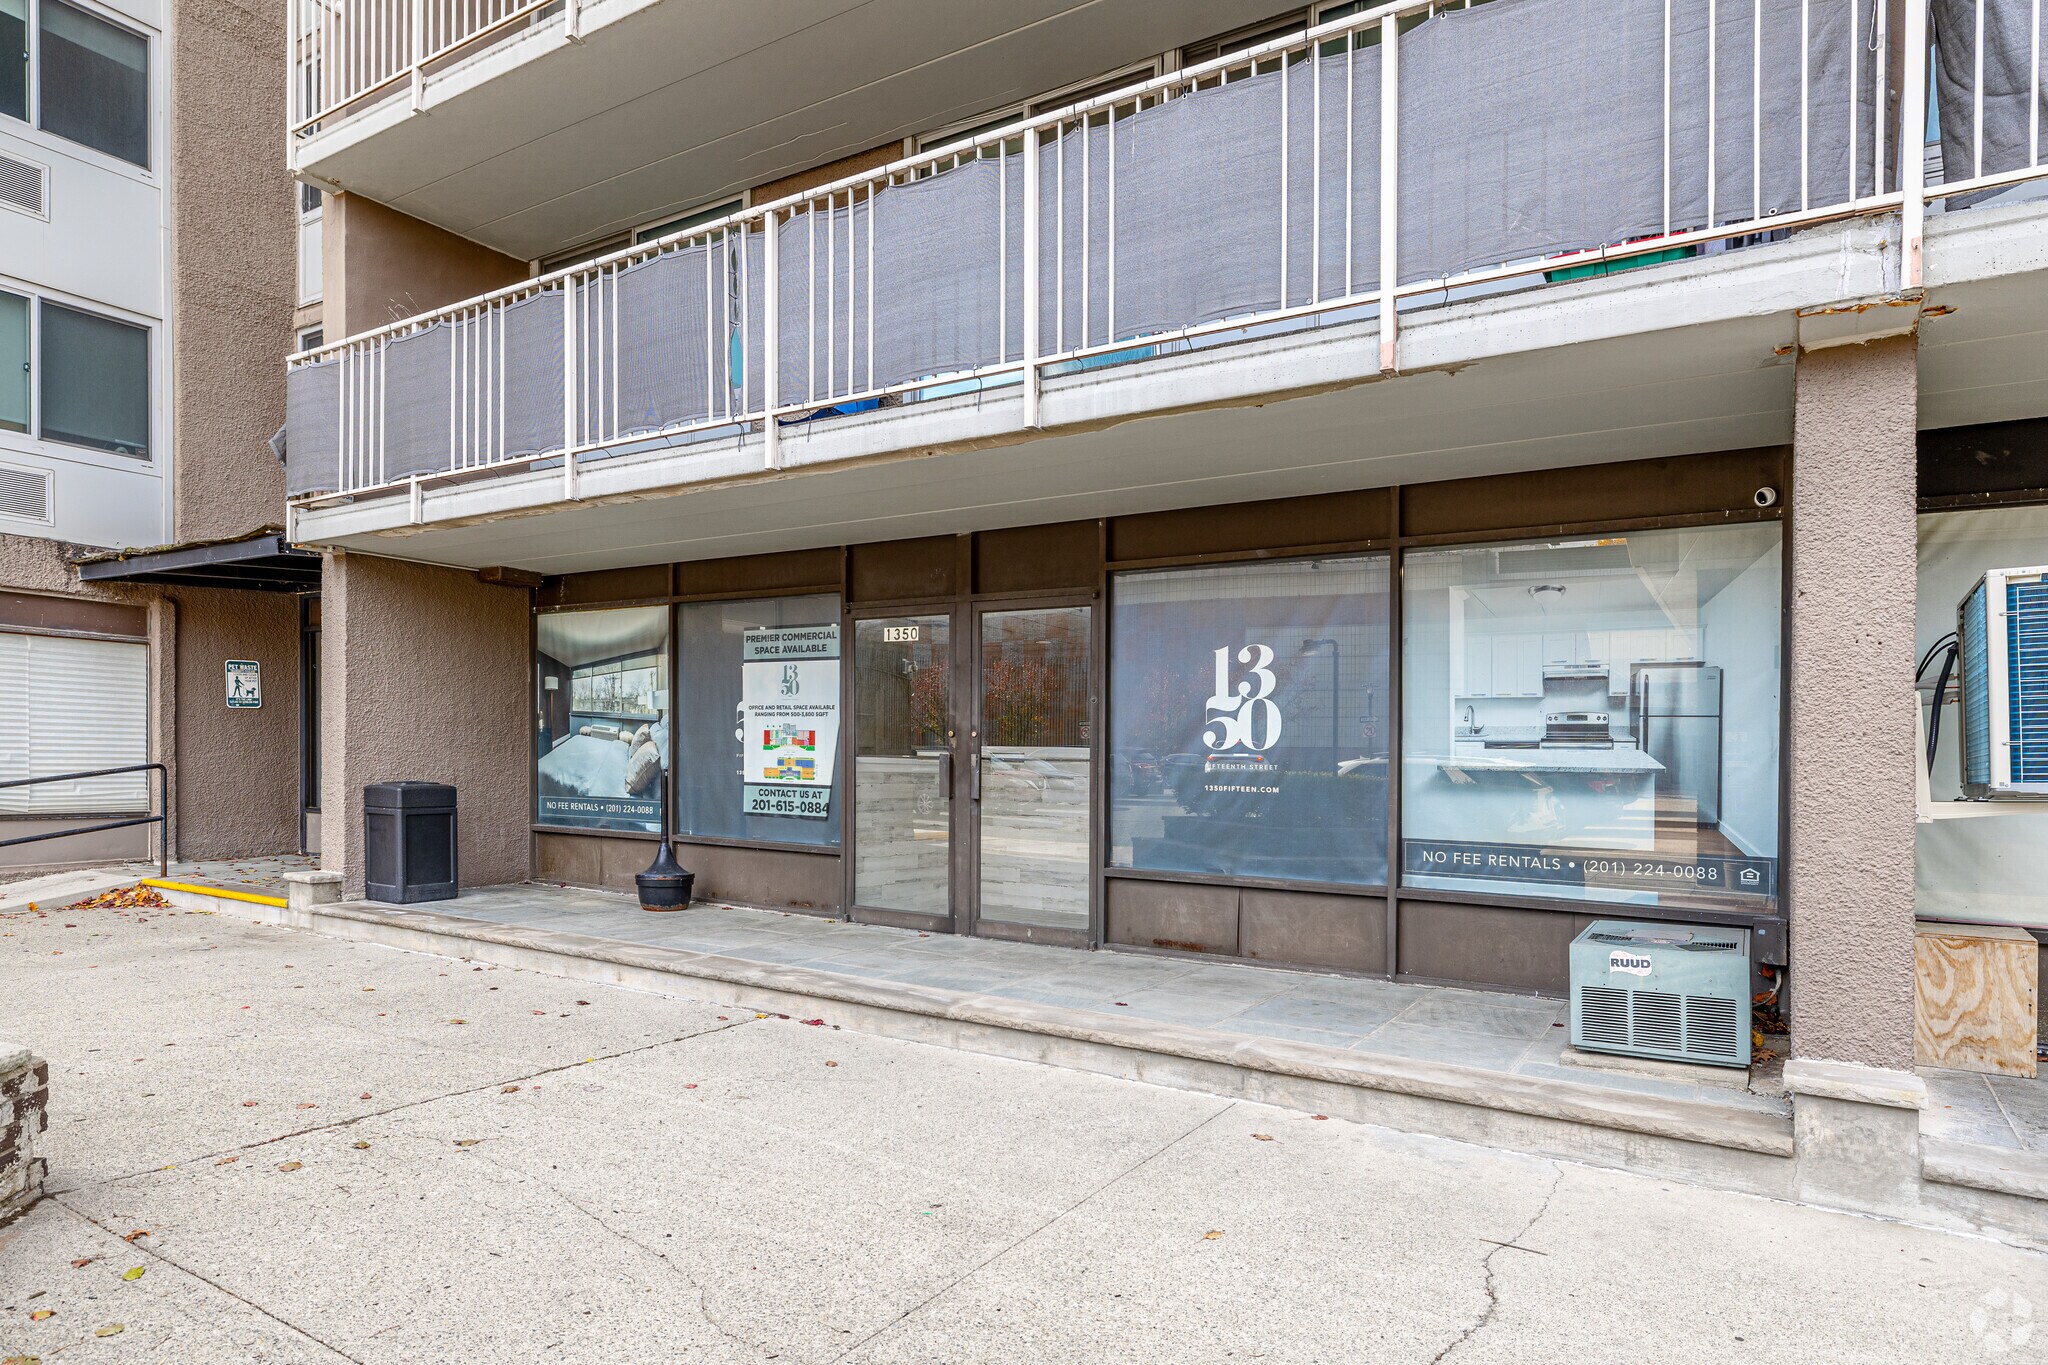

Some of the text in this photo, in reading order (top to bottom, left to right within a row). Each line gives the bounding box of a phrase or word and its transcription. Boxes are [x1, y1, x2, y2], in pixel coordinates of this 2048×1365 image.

[746, 631, 837, 643] PREMIER COMMERCIAL
[887, 627, 918, 641] 1350
[754, 644, 828, 655] SPACE AVAILABLE
[783, 664, 799, 682] 13
[758, 788, 823, 800] CONTACT US AT
[1204, 785, 1280, 794] 1350FIFTEEN.COM
[557, 802, 569, 810] FEE
[570, 802, 599, 812] RENTALS
[605, 804, 621, 813] (201)
[623, 805, 654, 814] 224-0088
[752, 799, 830, 814] 201-615-0884
[1422, 850, 1718, 880] NO FEE RENTALS (201) 224-0088
[1610, 958, 1651, 969] RUUD
